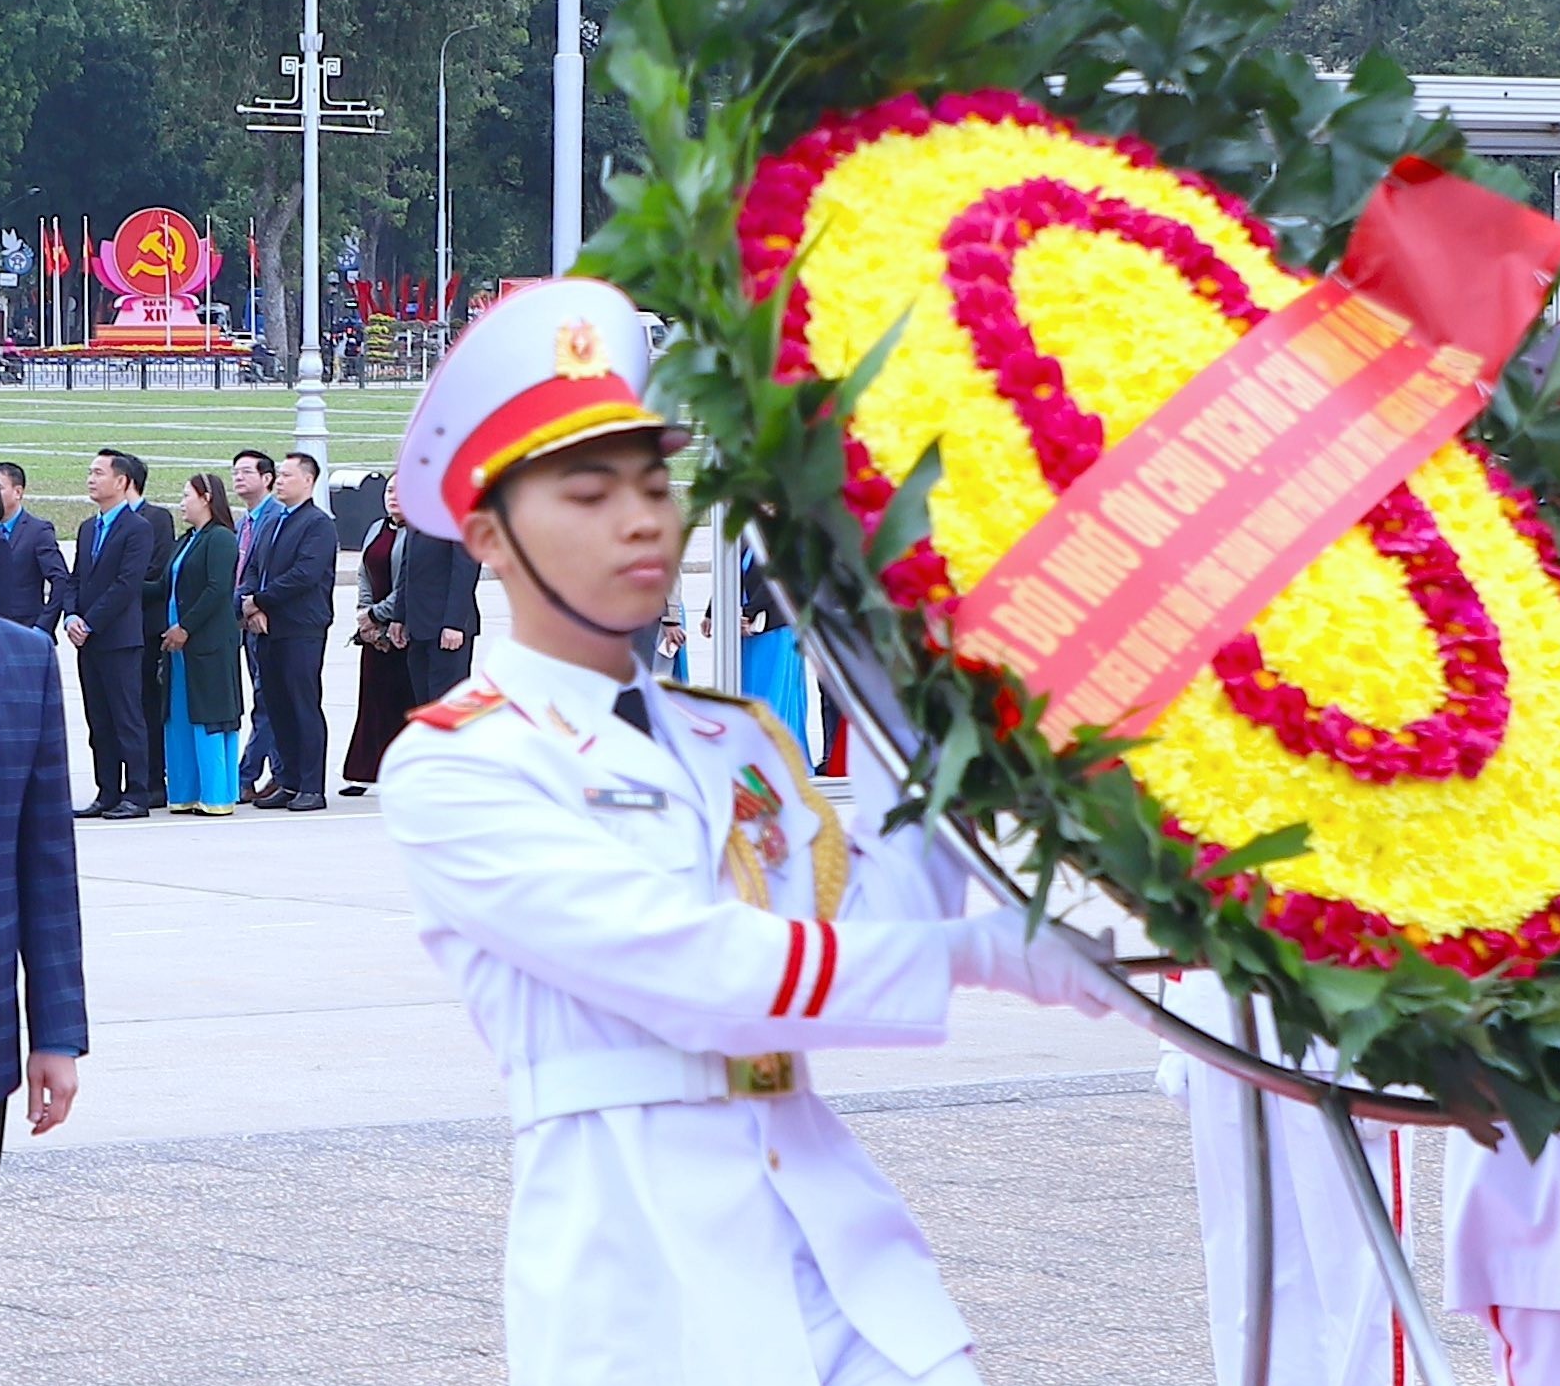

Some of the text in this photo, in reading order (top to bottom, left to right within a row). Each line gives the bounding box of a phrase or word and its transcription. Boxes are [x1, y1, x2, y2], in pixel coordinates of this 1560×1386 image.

[1222, 356, 1299, 436] HỒ
[1253, 338, 1330, 412] CHÍ
[1135, 423, 1228, 515] CHỦ
[1177, 391, 1274, 472] TỊCH
[1098, 480, 1182, 549] ƠN
[1038, 509, 1141, 608] NHỚ
[988, 573, 1088, 657] ĐỜI
